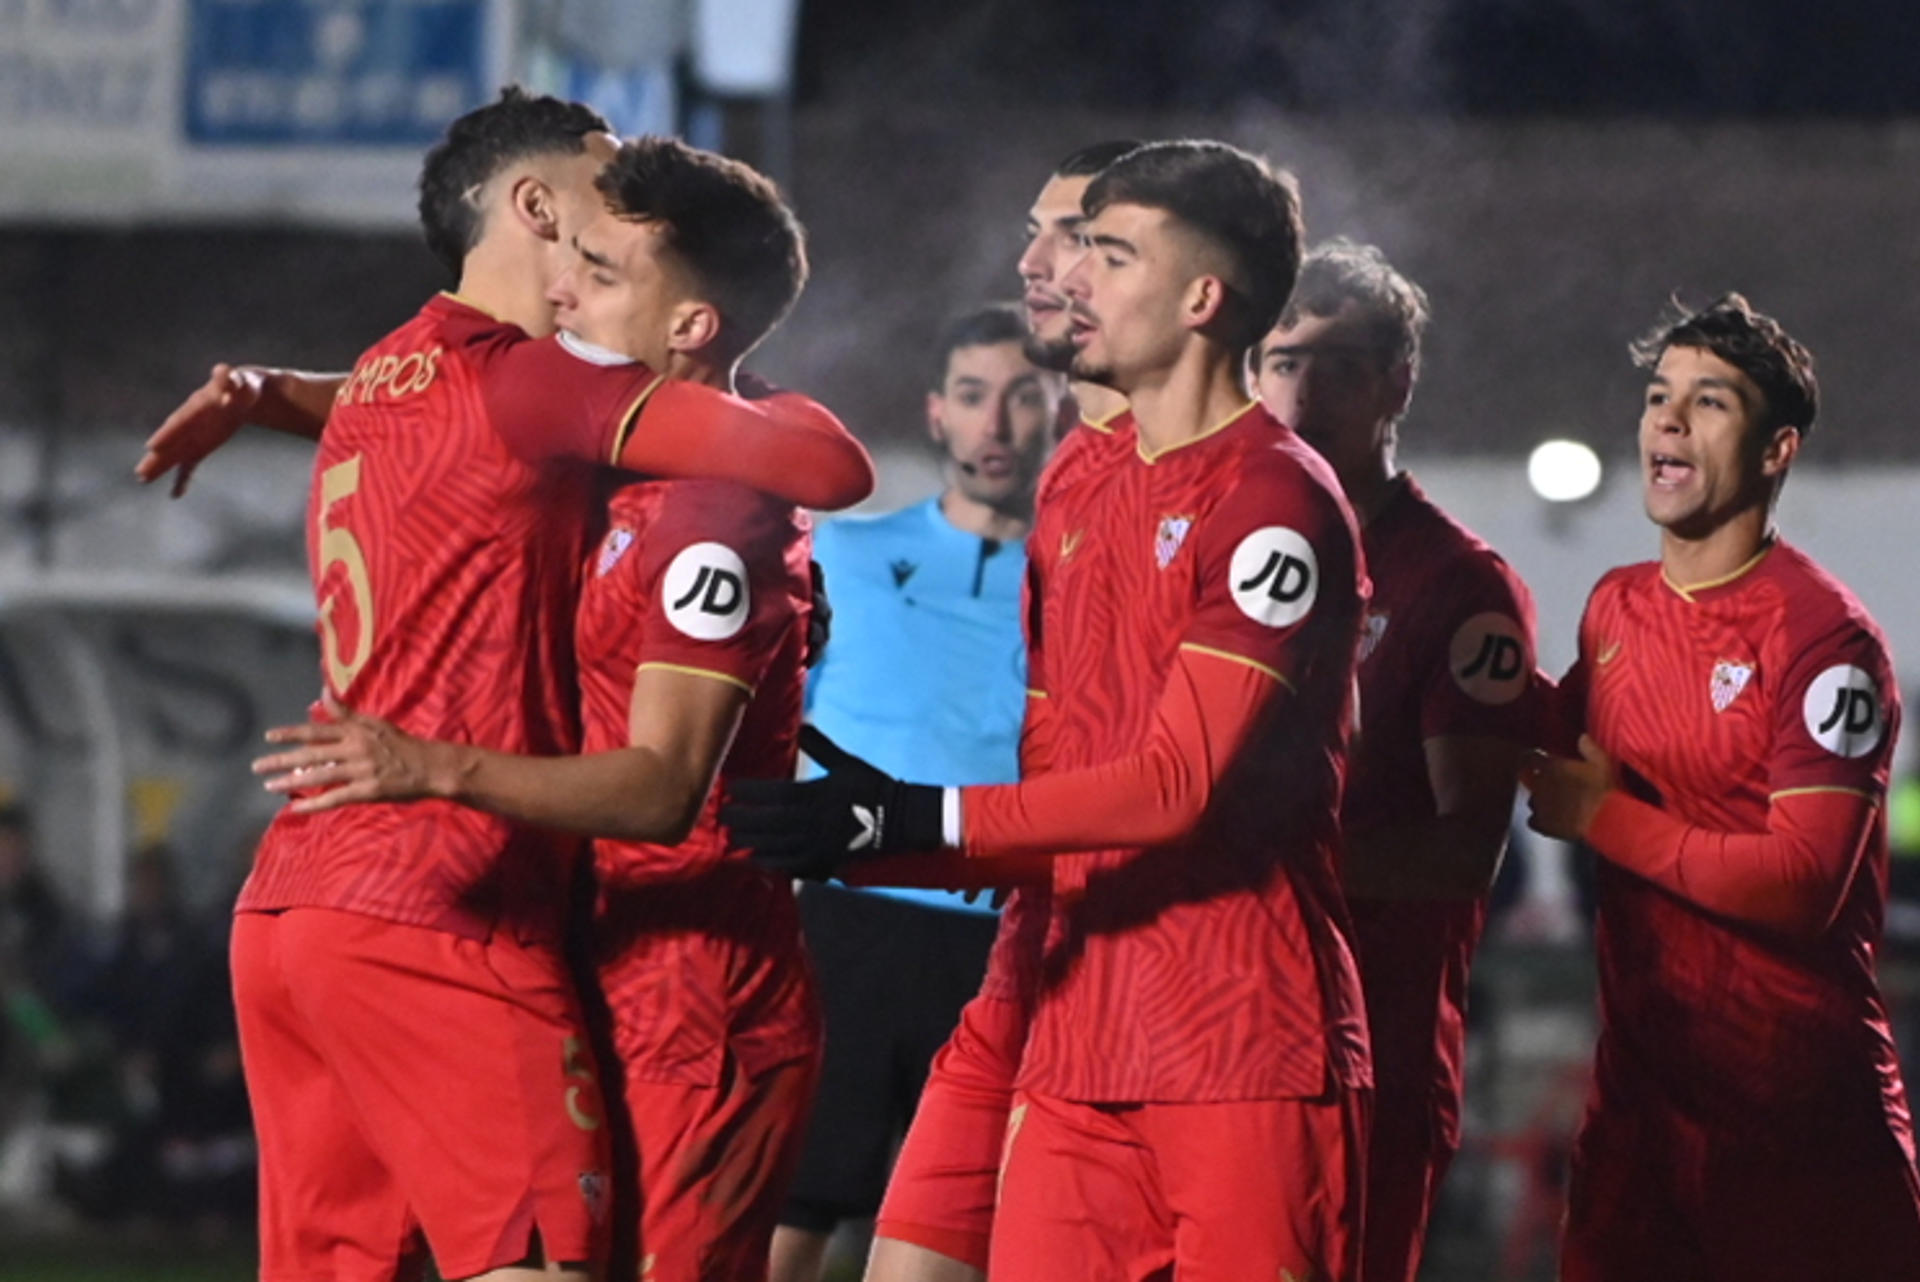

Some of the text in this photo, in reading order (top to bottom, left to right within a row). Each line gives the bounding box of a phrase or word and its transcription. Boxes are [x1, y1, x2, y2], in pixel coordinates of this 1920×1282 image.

[319, 449, 374, 698] 5
[673, 565, 743, 616] JD
[1238, 549, 1311, 604] JD
[1460, 633, 1523, 681] JD
[1818, 686, 1875, 735] JD
